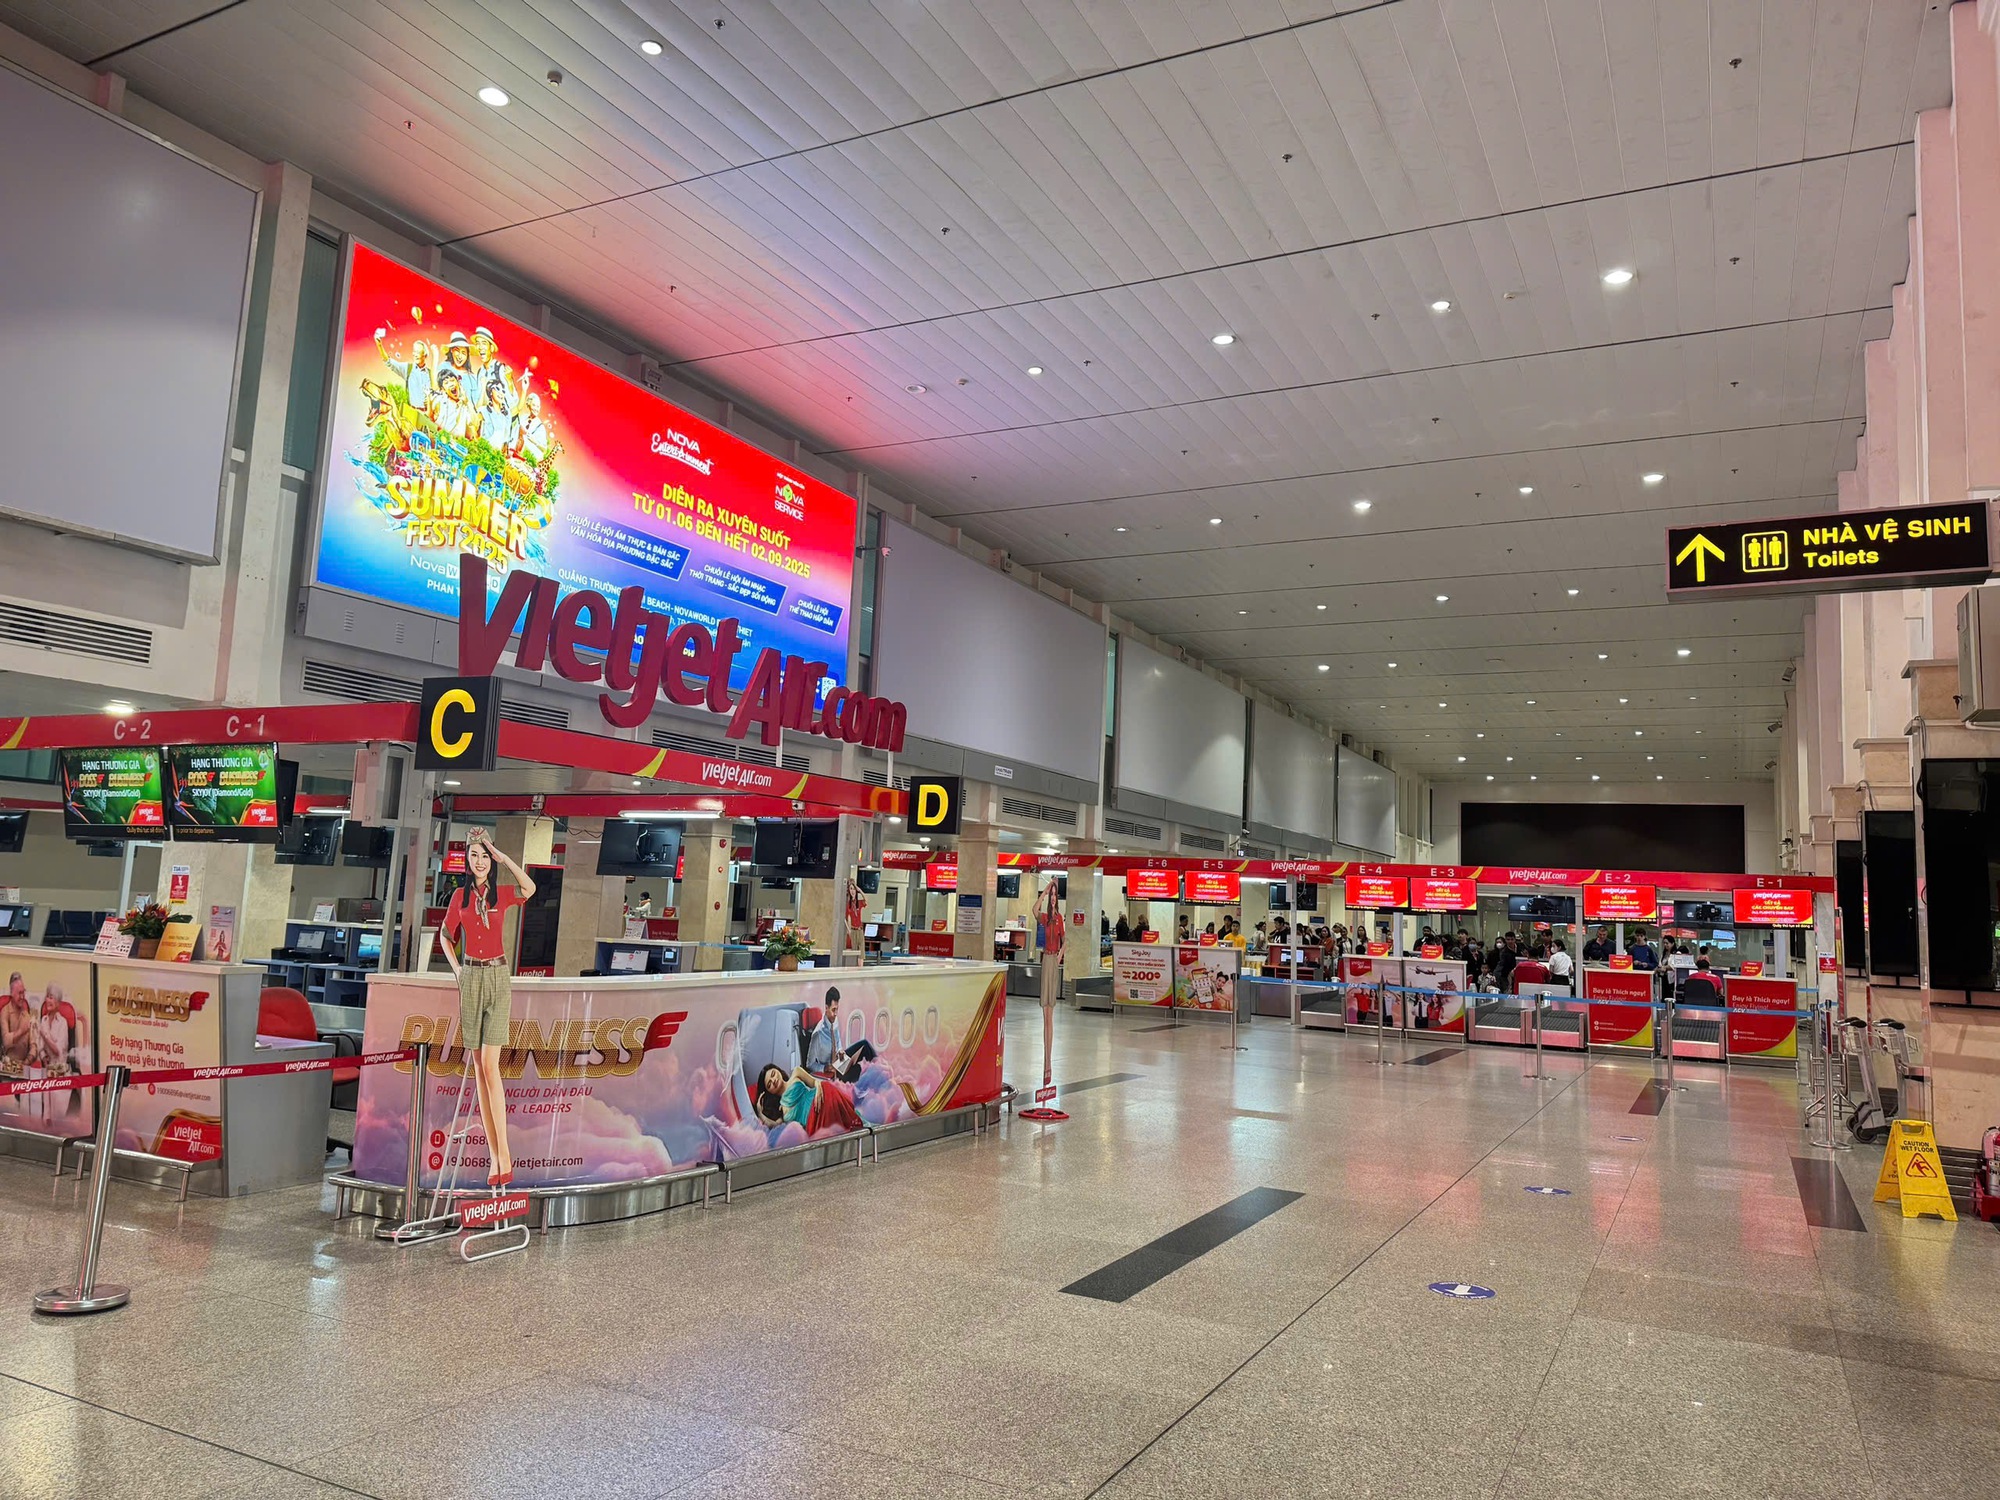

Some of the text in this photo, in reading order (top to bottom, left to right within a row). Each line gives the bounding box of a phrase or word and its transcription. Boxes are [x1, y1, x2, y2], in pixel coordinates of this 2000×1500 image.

[667, 429, 700, 454] NOVA
[385, 476, 527, 560] SUMMER
[775, 500, 804, 521] SERVICE
[697, 498, 714, 519] RA
[717, 507, 757, 537] XUYÊN
[760, 526, 791, 550] SUỐT
[1803, 517, 1971, 545] NHÀ VỆ SINH
[632, 492, 811, 578] TỪ 01.06 ĐẾN HẾT 02.09.2025
[406, 521, 508, 575] FEST 2025
[1803, 550, 1880, 568] Toilets
[428, 579, 454, 595] PHAN
[647, 596, 670, 612] BEACH
[674, 605, 716, 625] NOVAWORLD
[429, 688, 477, 758] C
[129, 760, 140, 769] GIA
[241, 757, 253, 767] GIA
[917, 783, 949, 826] D
[1132, 971, 1154, 980] 200
[107, 984, 191, 1022] BUSINESS
[1754, 996, 1771, 1004] Thích
[111, 1035, 184, 1055] Bay hạng Thương Gia
[110, 1051, 125, 1060] Món
[126, 1054, 140, 1065] quà
[142, 1055, 156, 1067] yêu
[522, 1103, 572, 1114] LEADERS
[1903, 1140, 1930, 1148] CAUTION
[1913, 1146, 1935, 1154] FLOOR
